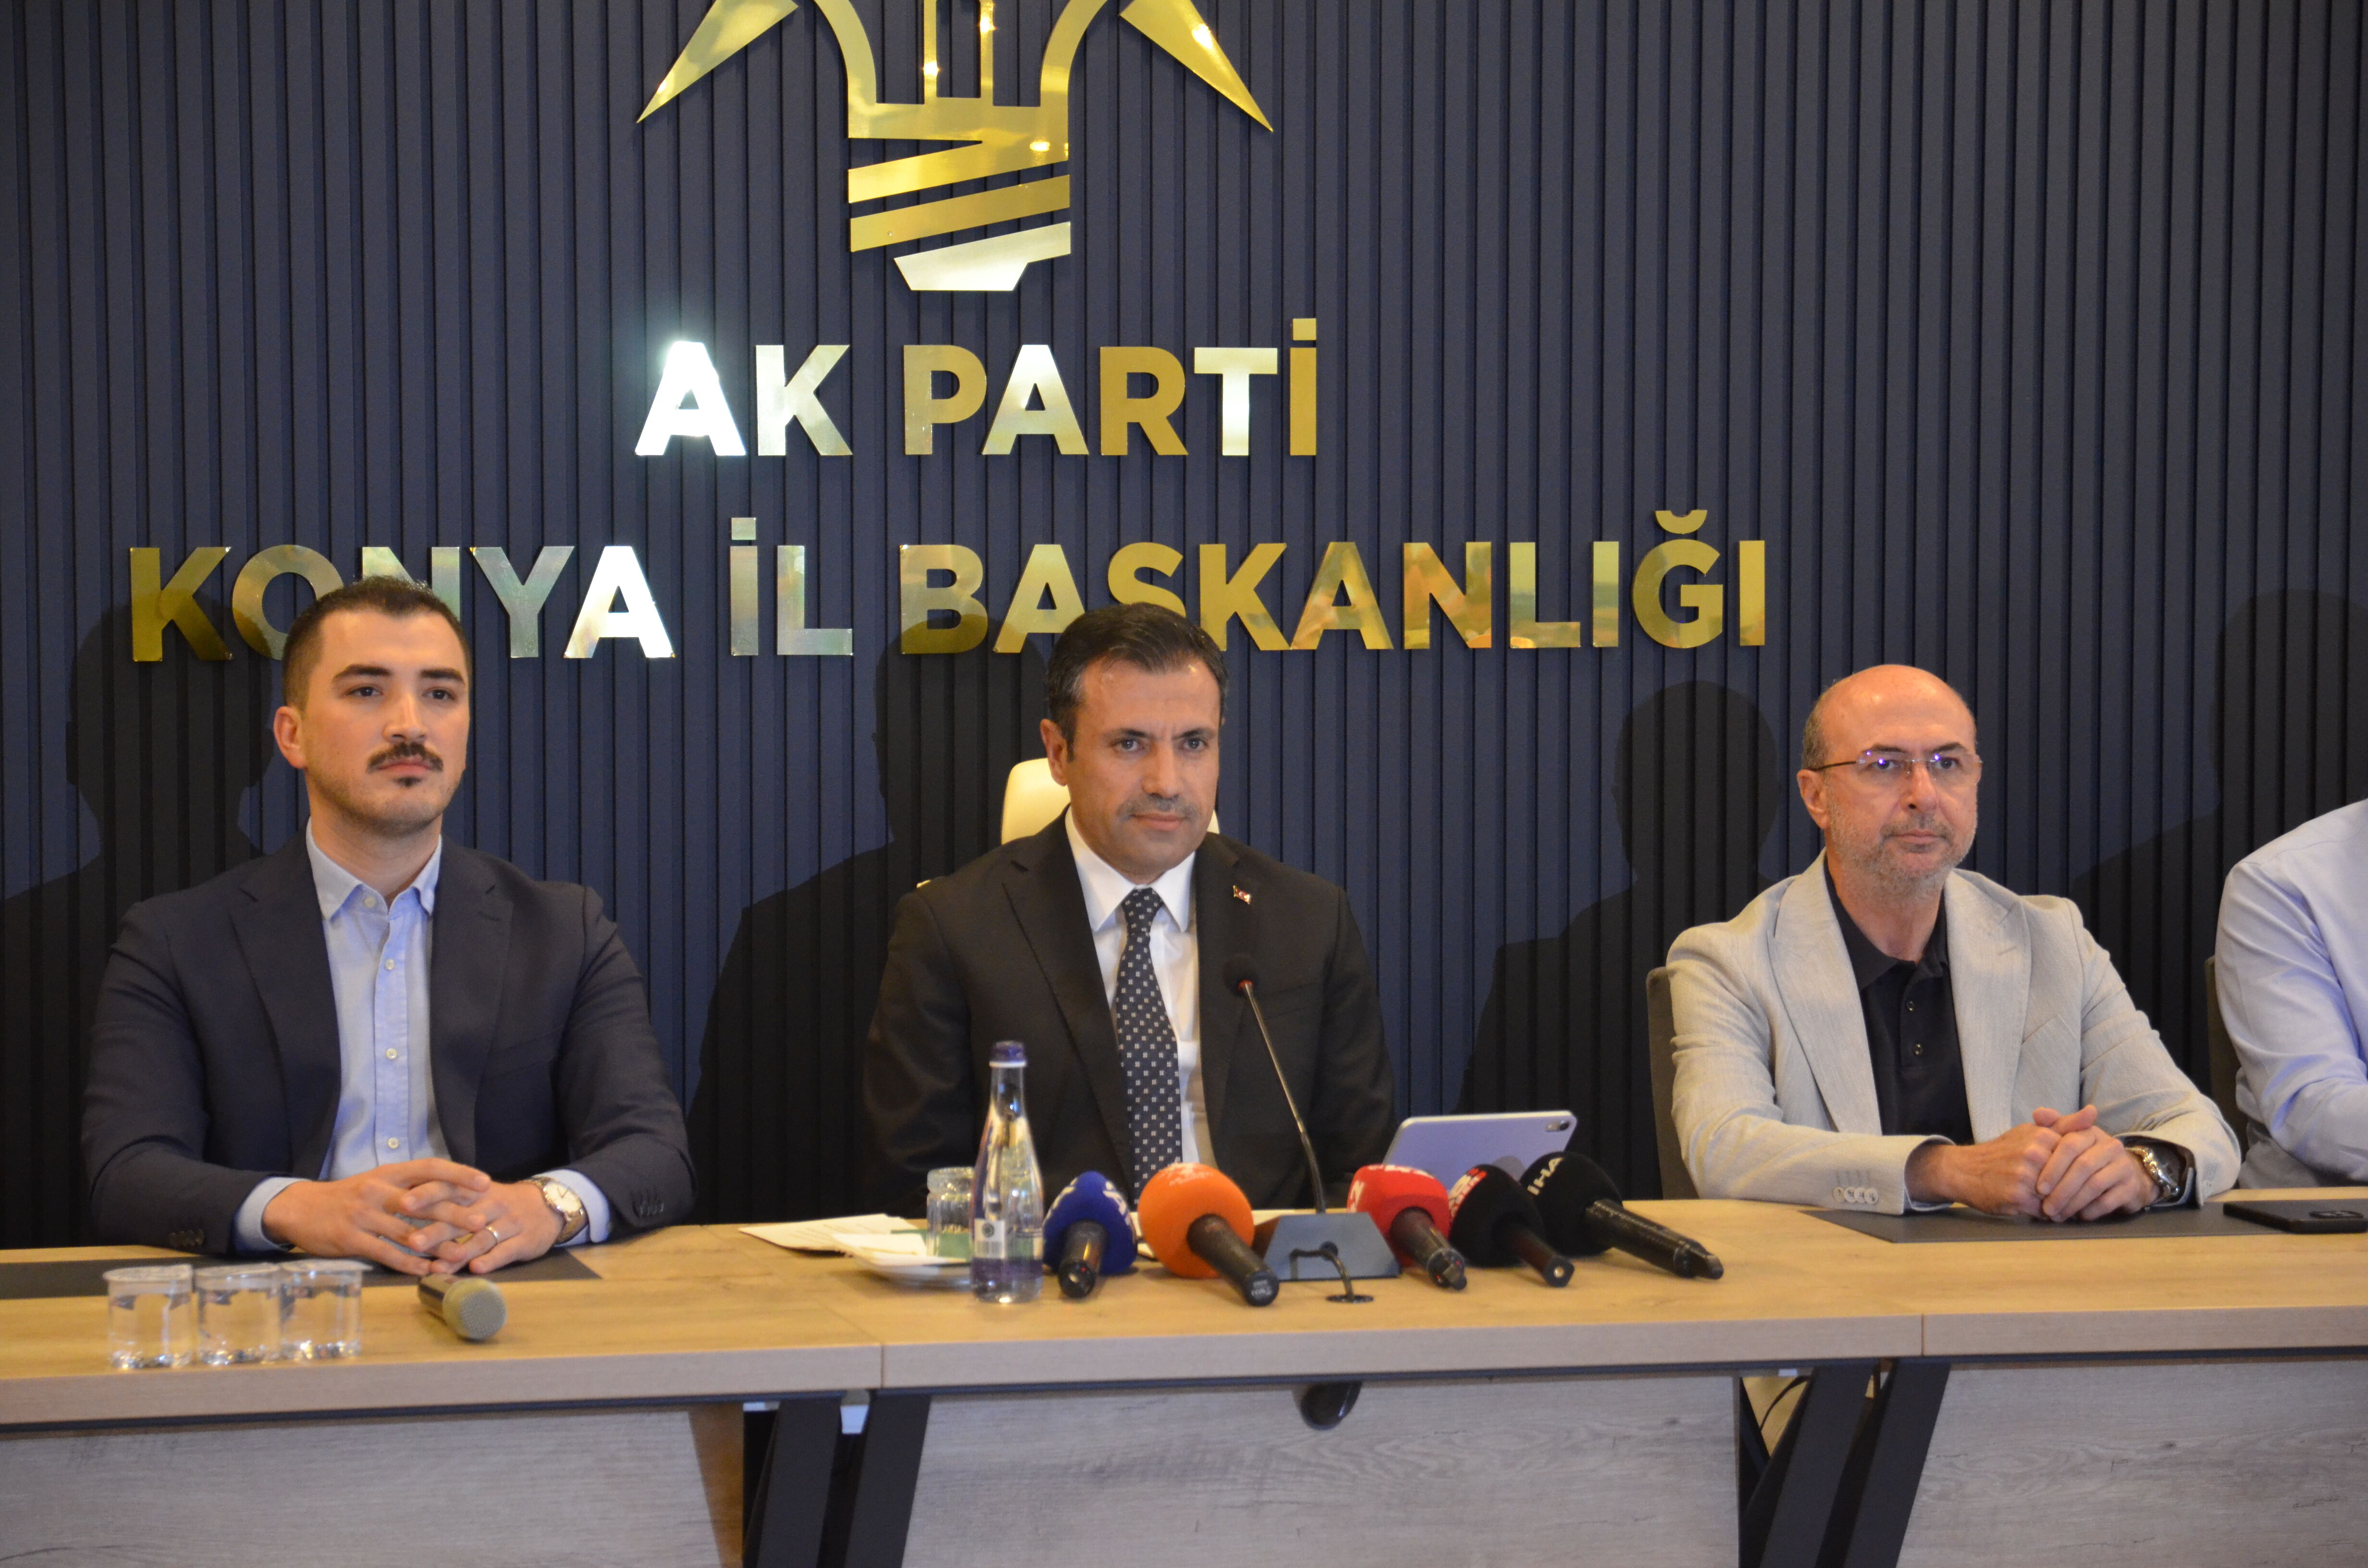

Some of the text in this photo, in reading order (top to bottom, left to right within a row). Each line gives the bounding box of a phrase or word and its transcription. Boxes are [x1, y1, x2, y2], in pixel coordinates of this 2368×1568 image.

[635, 318, 1317, 457] AK PARTİ
[729, 517, 853, 656] İL
